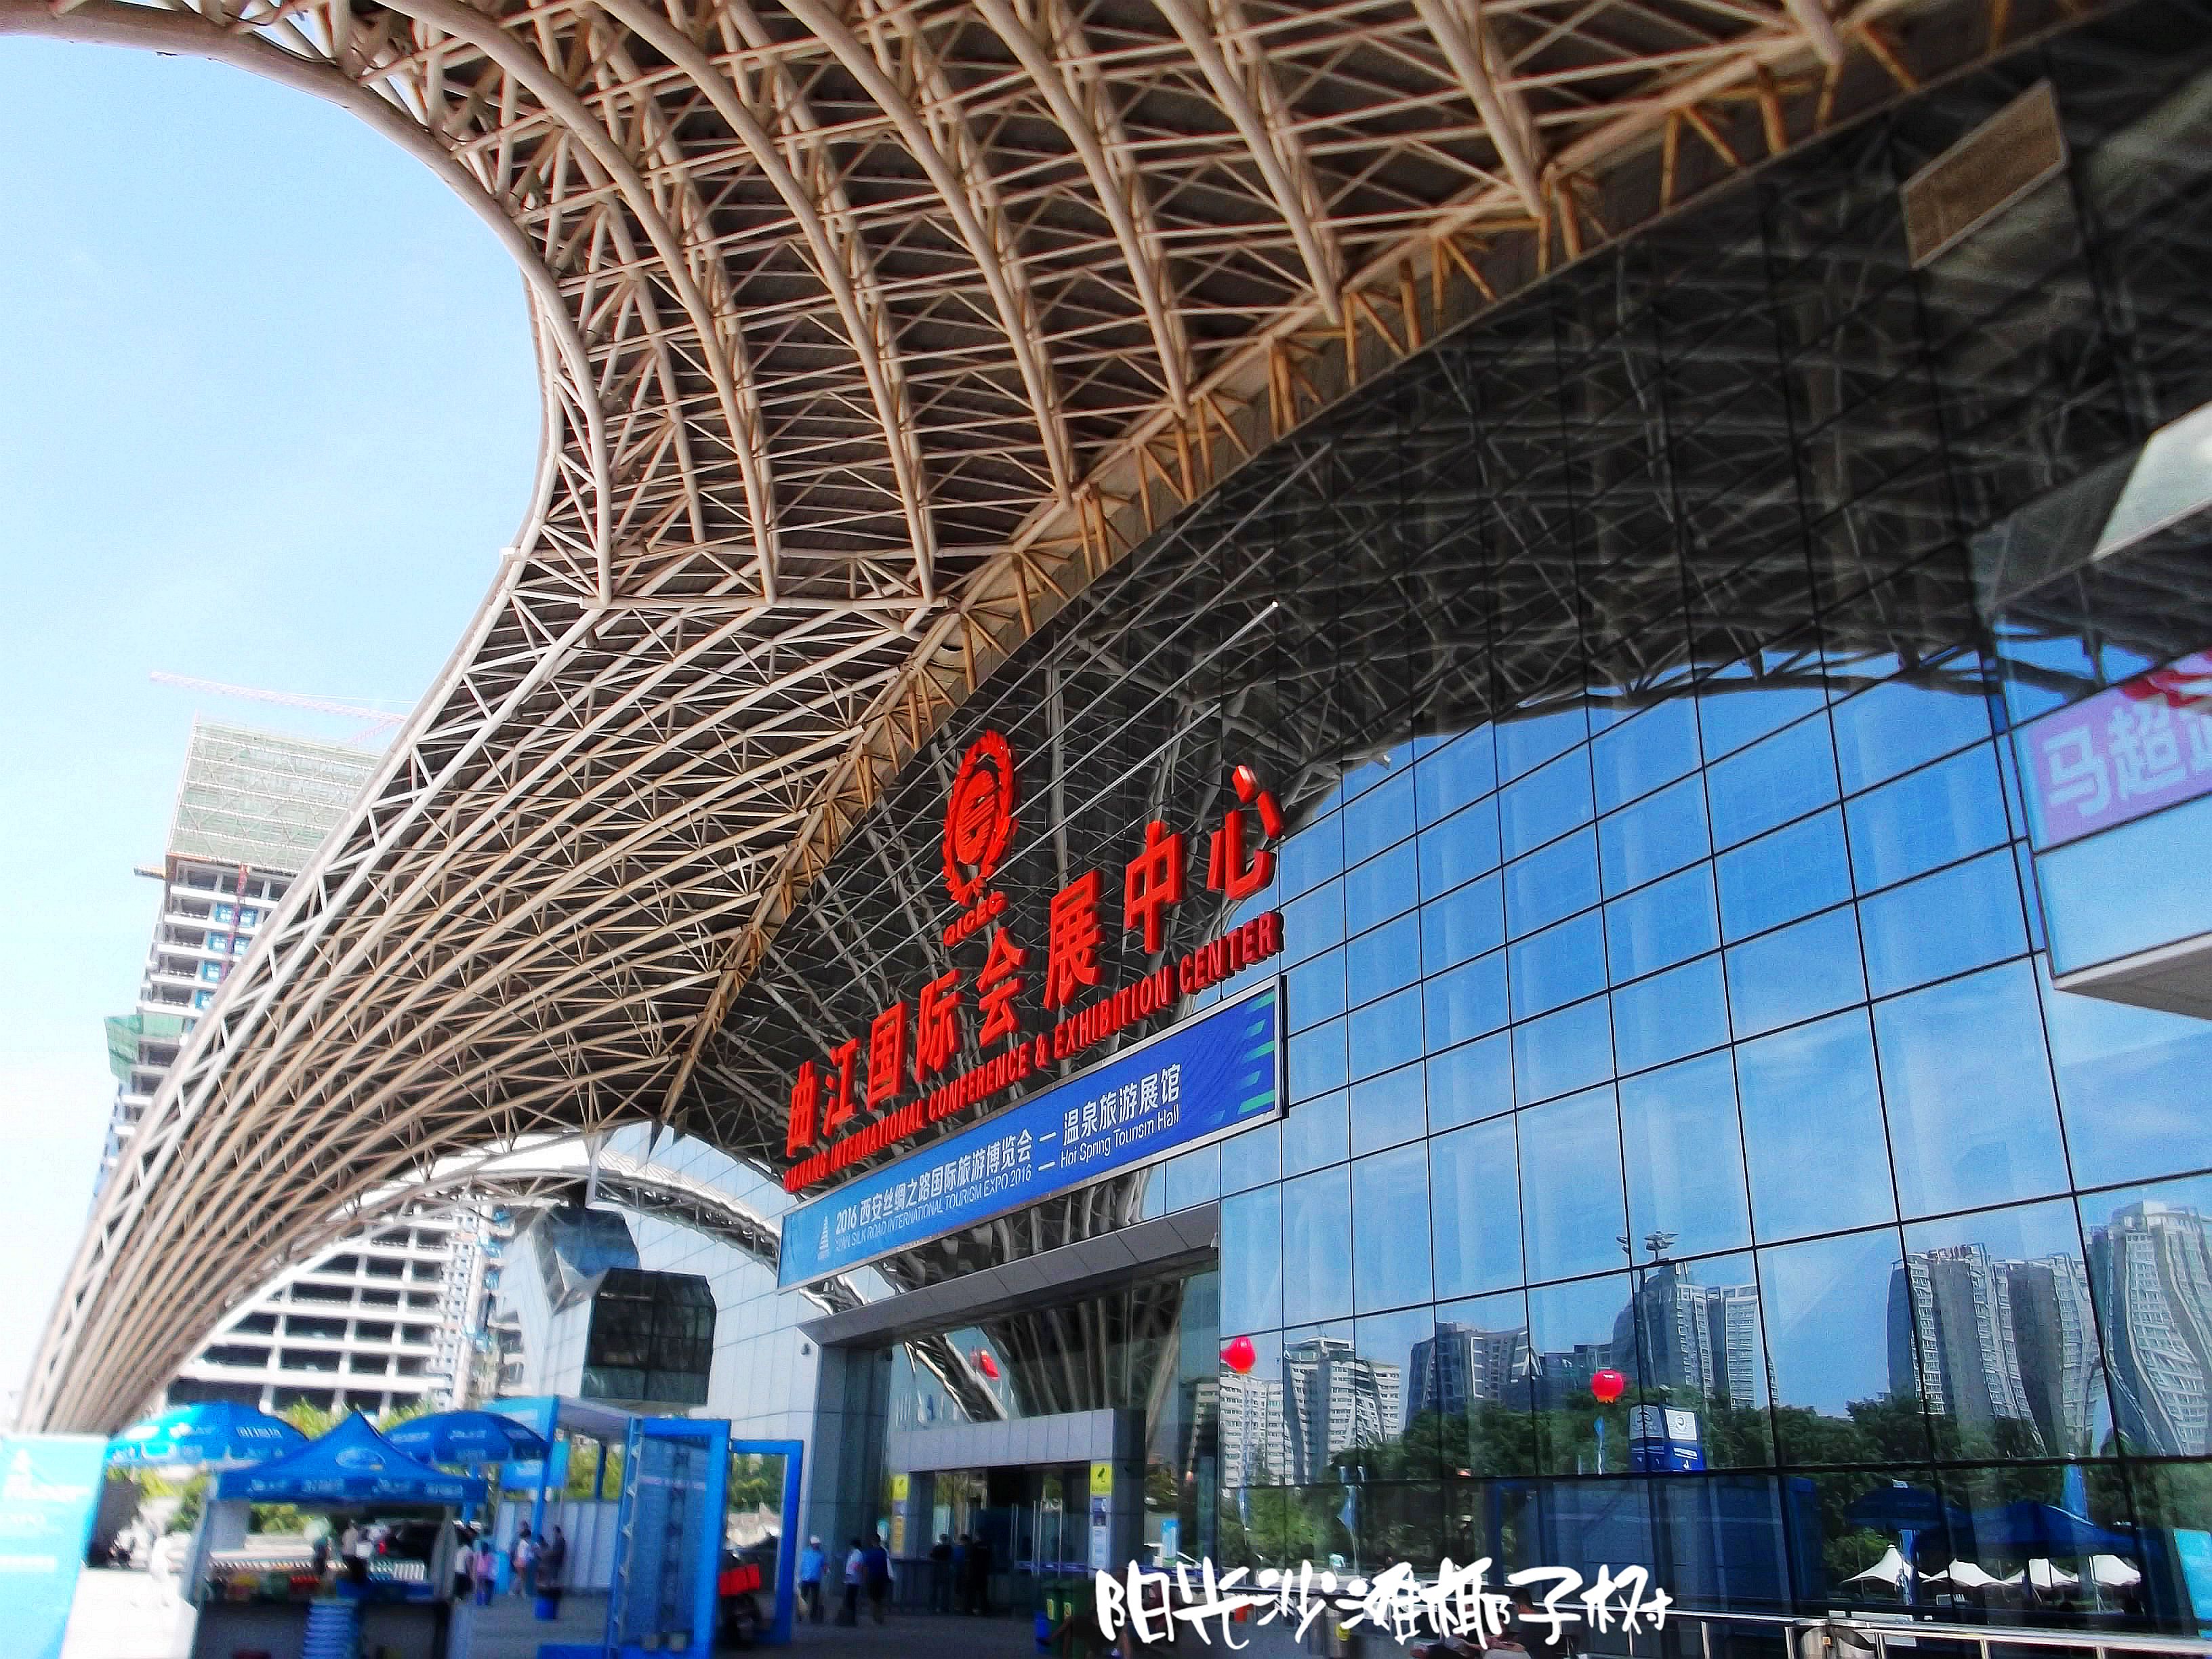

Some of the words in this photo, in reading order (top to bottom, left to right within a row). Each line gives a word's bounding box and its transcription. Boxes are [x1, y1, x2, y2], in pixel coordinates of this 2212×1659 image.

[785, 765, 1285, 1158] 曲江国际会展中心
[830, 1099, 927, 1172] INTERNATIONAL
[928, 1040, 1031, 1123] CONFERENCE
[1035, 1032, 1051, 1069] &
[1054, 965, 1179, 1060] EXHIBITION
[1179, 911, 1285, 995] CENTER
[835, 1205, 857, 1235] 2016
[859, 1128, 1033, 1226] 西安丝绸之路国际旅游博览会
[1063, 1063, 1181, 1147] 温泉旅游展馆
[867, 1220, 886, 1240] ROAD
[888, 1199, 943, 1232] INTERNATIONAL
[945, 1187, 983, 1213] TOURISM
[983, 1172, 1008, 1198] EXPO
[1008, 1164, 1032, 1187] 2016
[1080, 1136, 1111, 1163] Spring
[1113, 1118, 1154, 1148] Tourism
[1157, 1103, 1180, 1132] Hall
